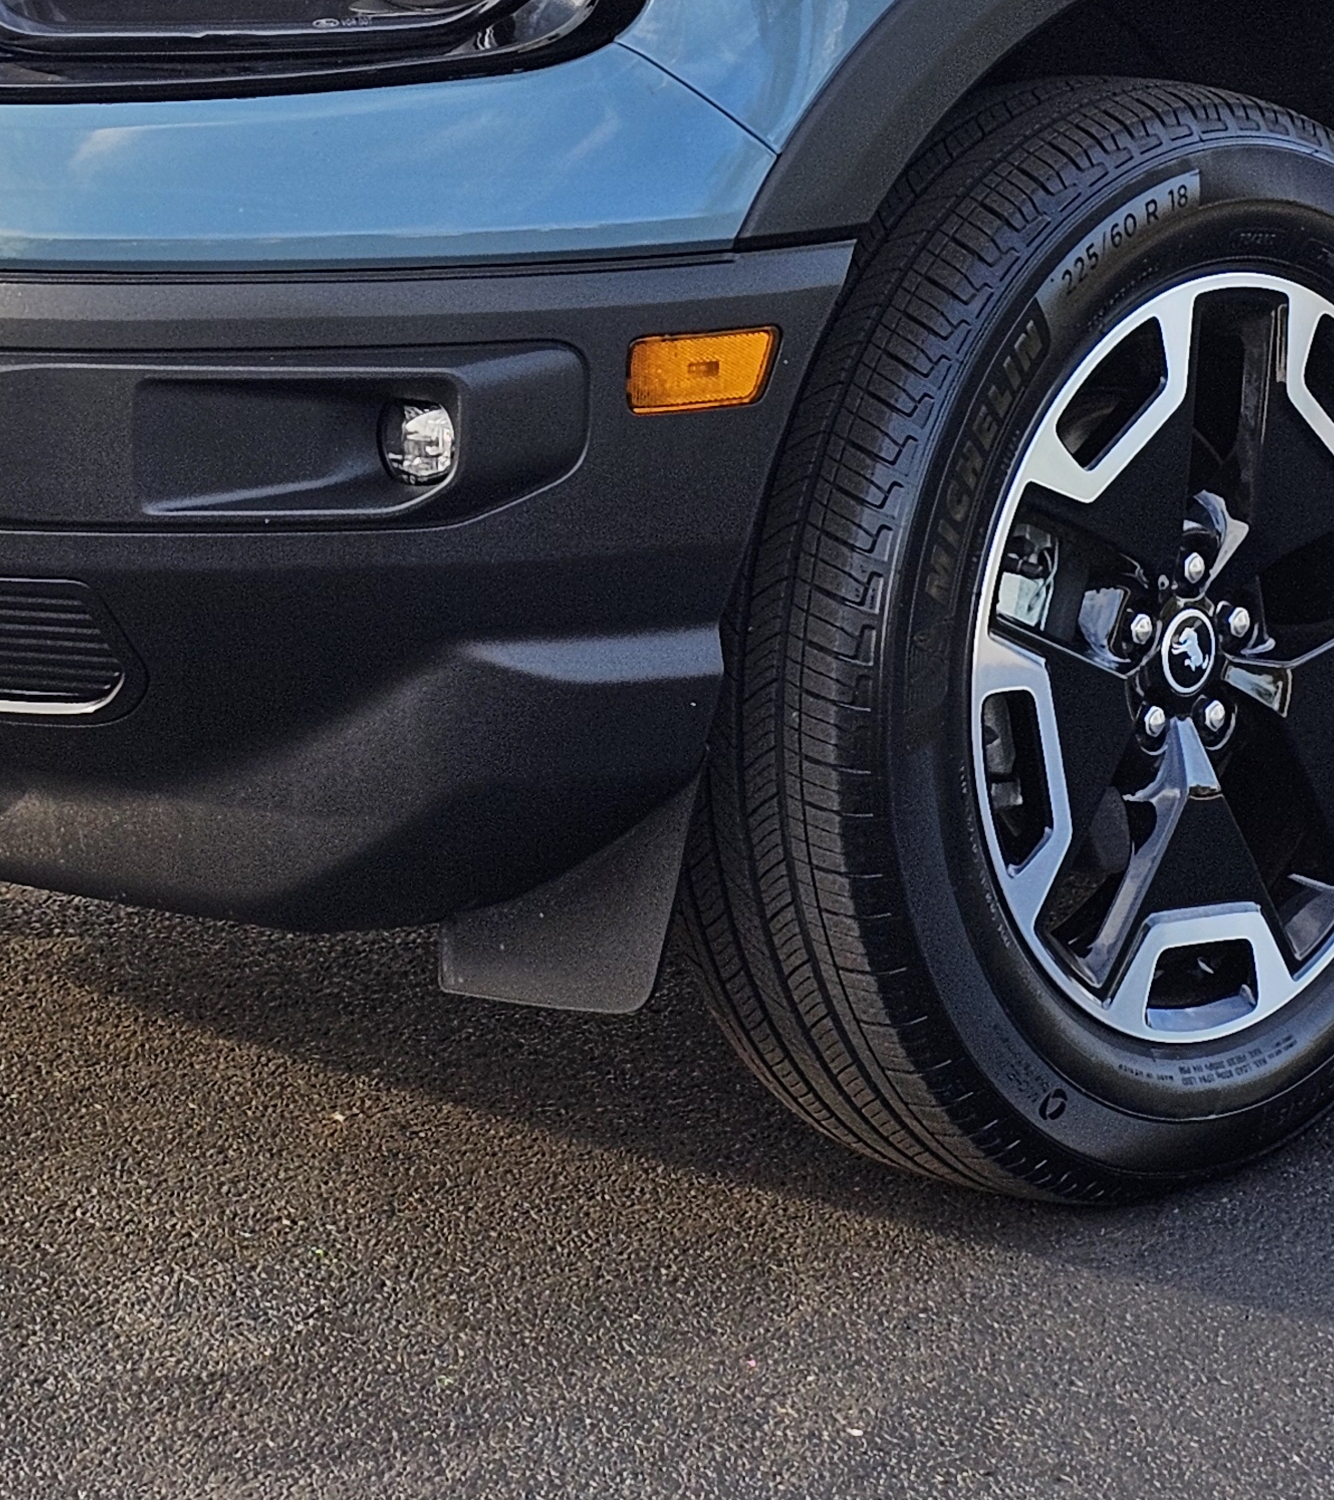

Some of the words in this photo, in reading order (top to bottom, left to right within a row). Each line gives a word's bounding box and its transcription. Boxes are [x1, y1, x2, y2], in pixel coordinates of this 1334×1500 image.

[1061, 212, 1137, 295] 225/60
[1145, 198, 1159, 225] R
[1167, 184, 1189, 211] 18
[924, 318, 1043, 604] MICHELIN
